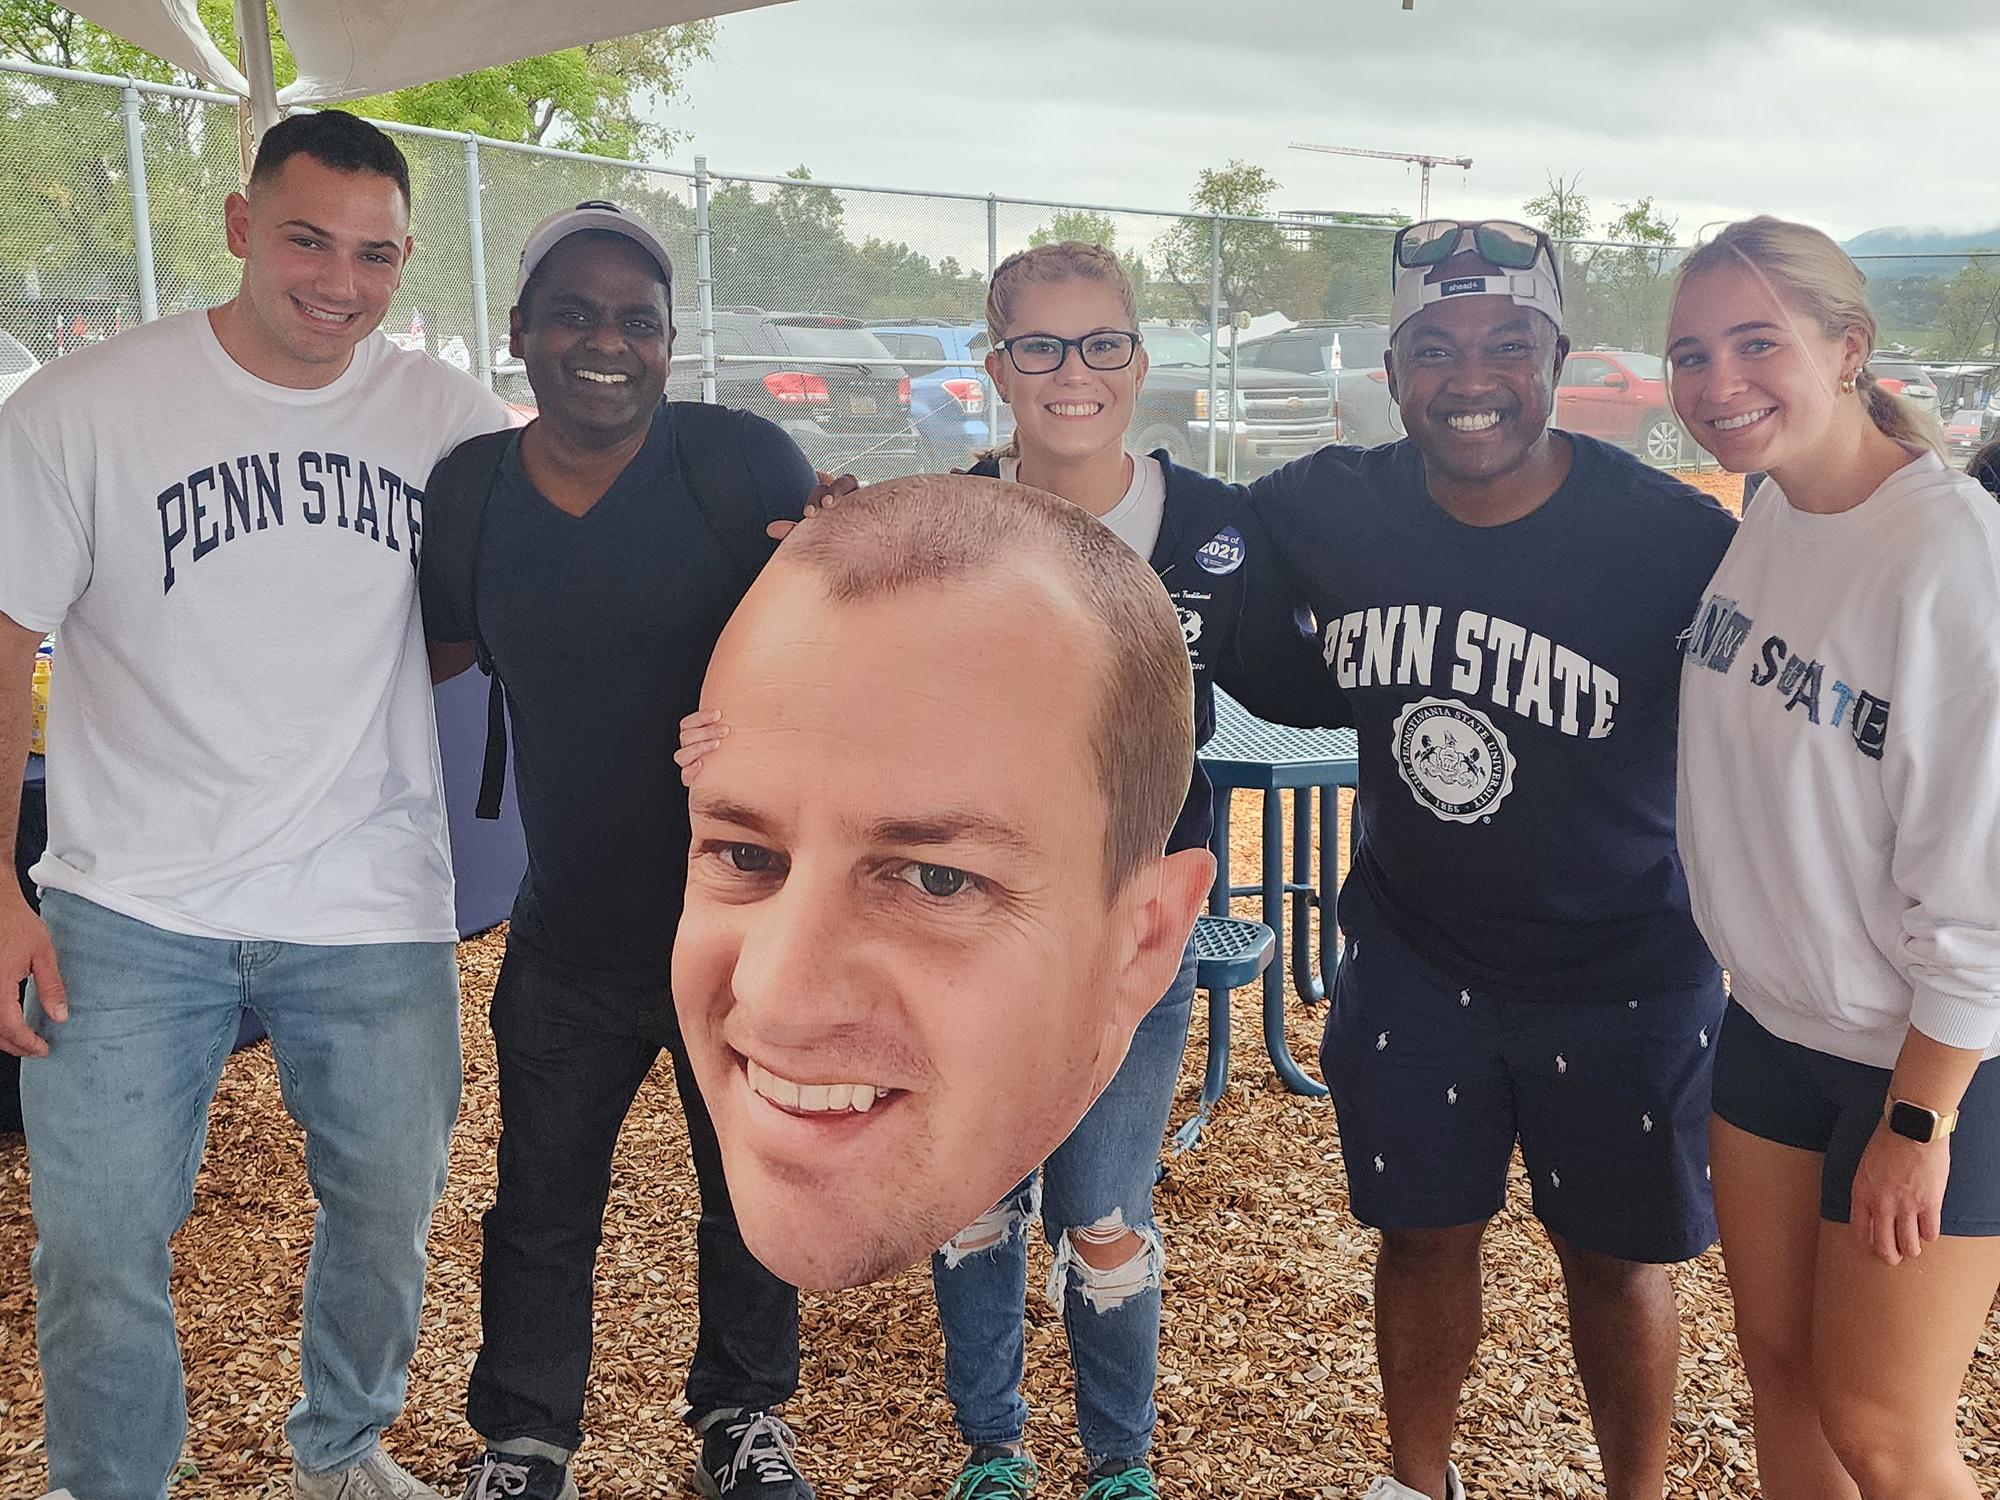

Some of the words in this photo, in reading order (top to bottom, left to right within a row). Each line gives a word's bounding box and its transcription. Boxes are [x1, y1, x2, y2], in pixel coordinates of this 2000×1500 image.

[157, 452, 284, 596] PENN
[1452, 610, 1619, 739] STATE
[1402, 706, 1452, 765] PENNSYLVANIA
[1454, 710, 1490, 740] STATE
[1406, 767, 1426, 793] THE
[1473, 741, 1502, 809] UNIVERSITY
[1434, 800, 1461, 813] 1855
